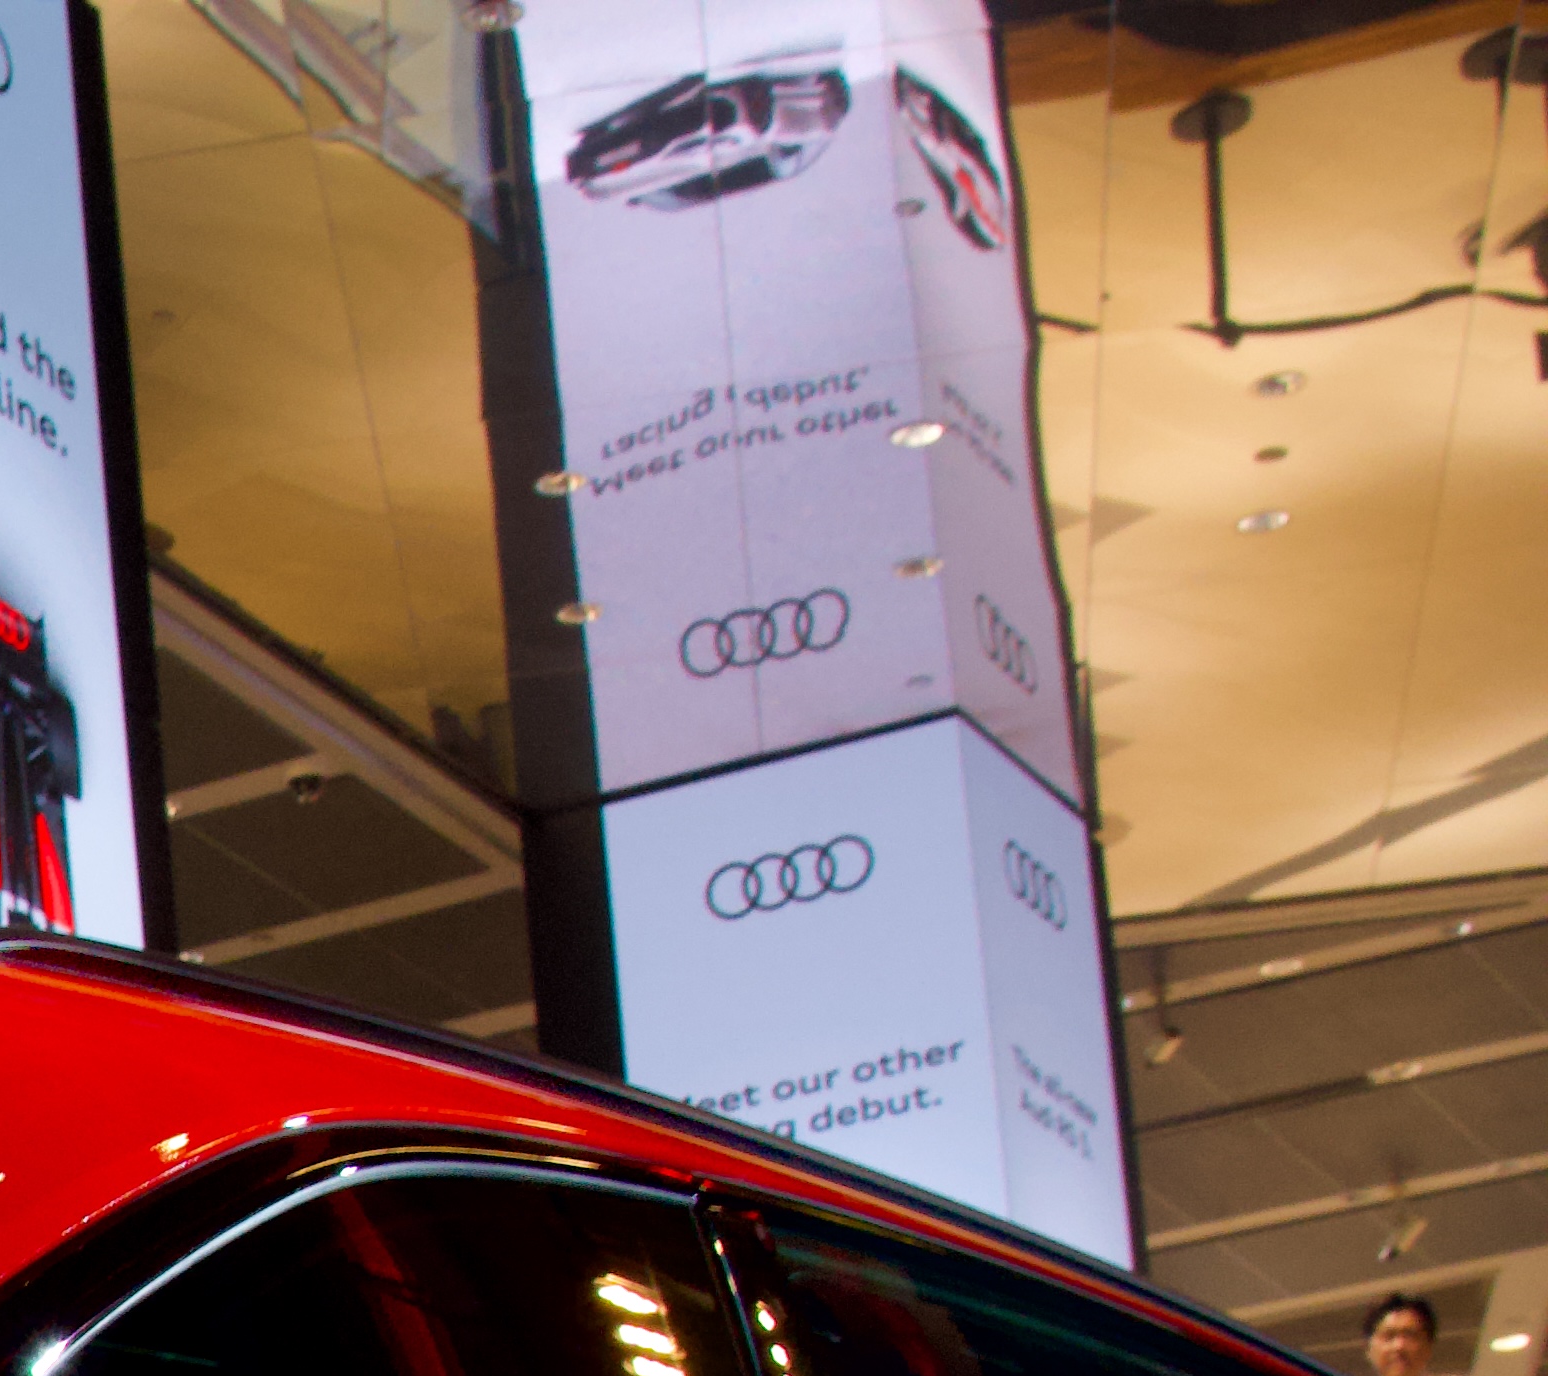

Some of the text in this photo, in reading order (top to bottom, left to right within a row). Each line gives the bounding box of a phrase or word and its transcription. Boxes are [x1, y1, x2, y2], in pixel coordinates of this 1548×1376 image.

[16, 331, 76, 401] the
[680, 1038, 965, 1113] eet our other
[807, 1084, 944, 1134] debut.
